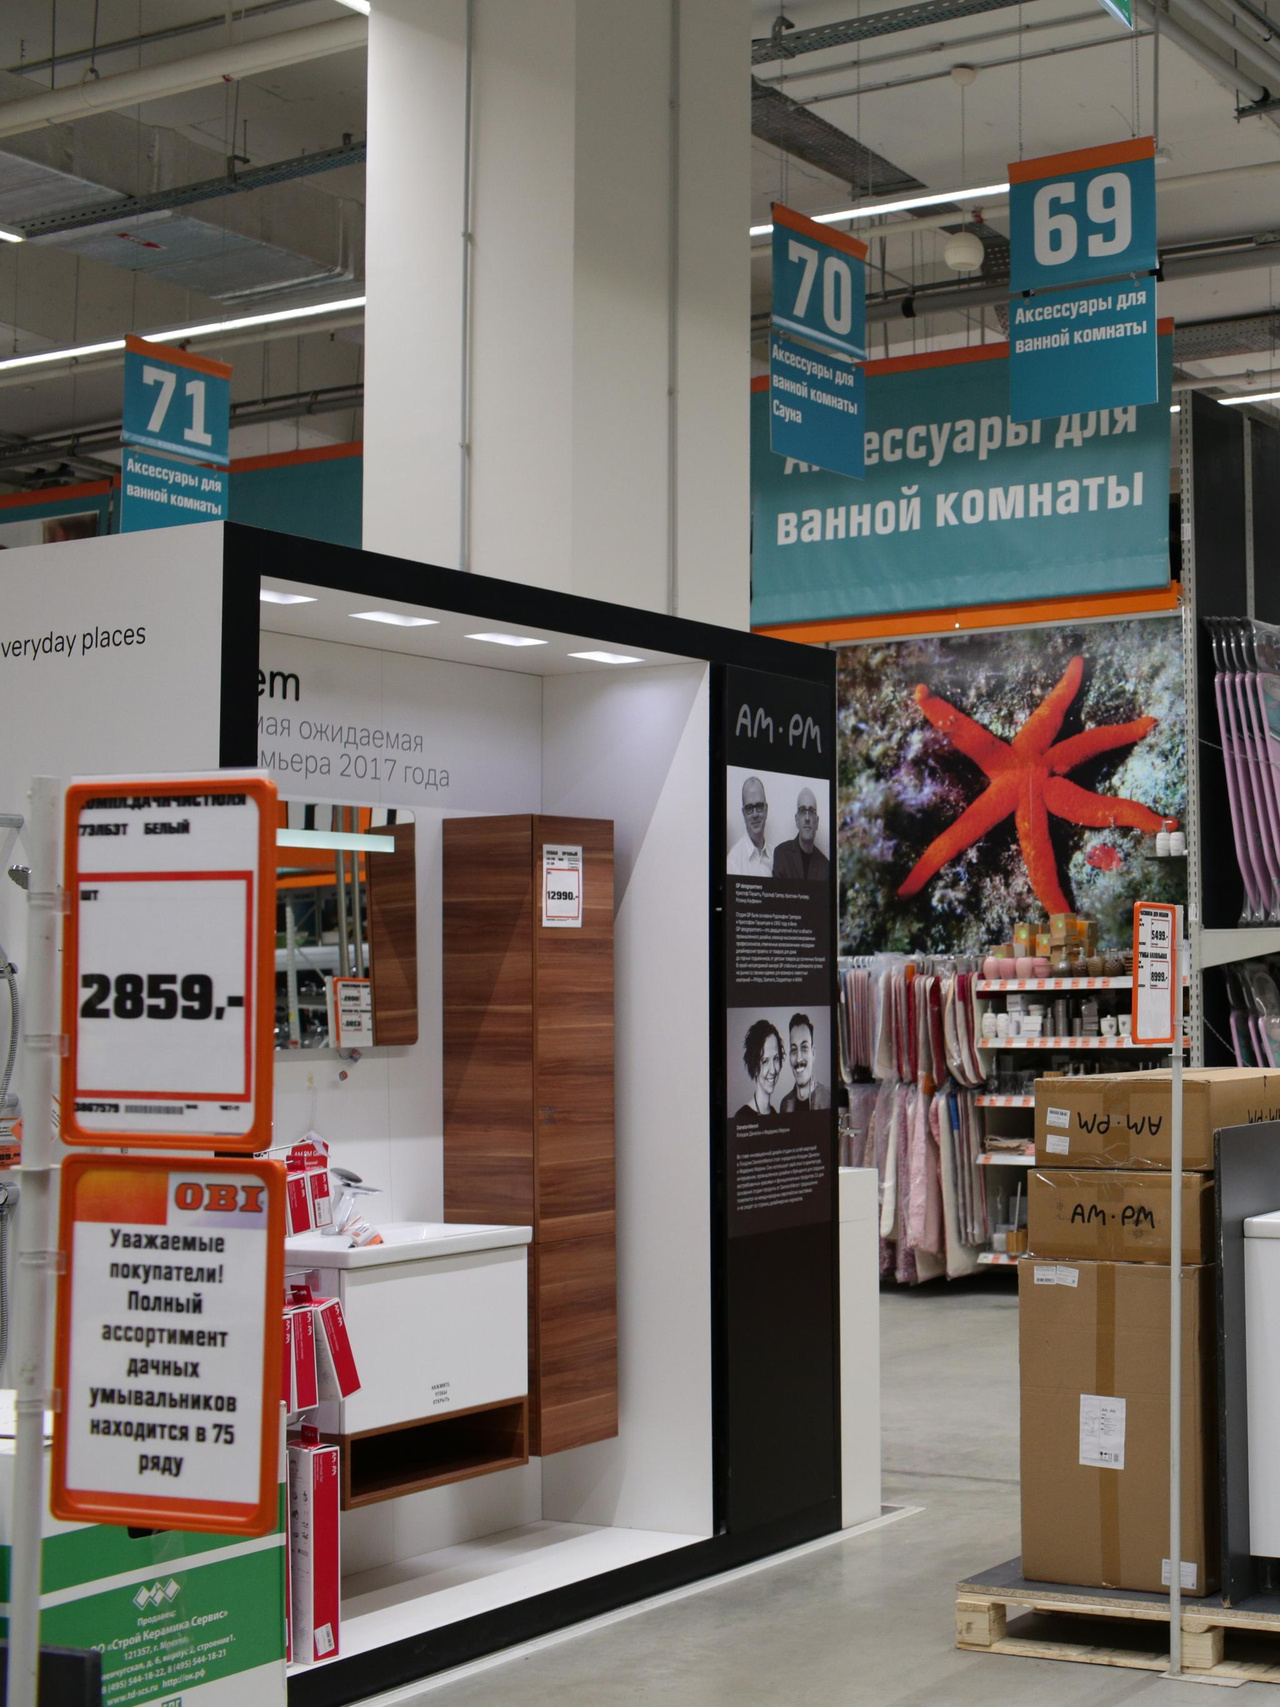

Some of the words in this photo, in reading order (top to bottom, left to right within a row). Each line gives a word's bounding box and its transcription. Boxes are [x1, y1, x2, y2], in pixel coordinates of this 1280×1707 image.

[1033, 171, 1133, 267] 69
[788, 240, 853, 335] 70
[1015, 295, 1113, 325] Аксессуары
[1116, 289, 1147, 311] для
[1015, 327, 1070, 354] ванной
[1073, 319, 1147, 345] комнаты
[772, 343, 833, 381] Аксессуары
[835, 368, 854, 388] для
[142, 365, 212, 447] 71
[772, 373, 808, 398] ванной
[810, 388, 858, 416] комнаты
[772, 400, 803, 424] Сауна
[784, 414, 1041, 475] ессуары
[1055, 404, 1138, 449] для
[127, 457, 199, 489] Аксессуары
[201, 477, 222, 494] для
[127, 483, 168, 504] ванной
[170, 493, 222, 516] комнаты
[777, 485, 921, 546] ванной
[936, 471, 1144, 528] комнаты
[0, 630, 77, 661] veryday
[81, 625, 146, 655] places
[299, 719, 424, 754] ожидаемая
[260, 749, 332, 780] мьера
[339, 752, 397, 781] 2017
[403, 766, 450, 791] года
[144, 819, 190, 836] БЕЛЫЙ
[175, 1183, 264, 1213] OBI
[110, 1229, 225, 1252] Уважаемые
[110, 1261, 223, 1284] покупатели!
[128, 1290, 203, 1315] Полный
[102, 1324, 228, 1348] ассортимент
[127, 1358, 200, 1379] дачных
[90, 1386, 237, 1413] умывальников
[90, 1418, 189, 1442] находится
[196, 1427, 206, 1442] в
[212, 1424, 235, 1445] 75
[139, 1453, 183, 1478] ряду
[143, 1620, 190, 1640] Керамика
[191, 1610, 228, 1627] Сервис»
[192, 1649, 227, 1666] 544-18-21
